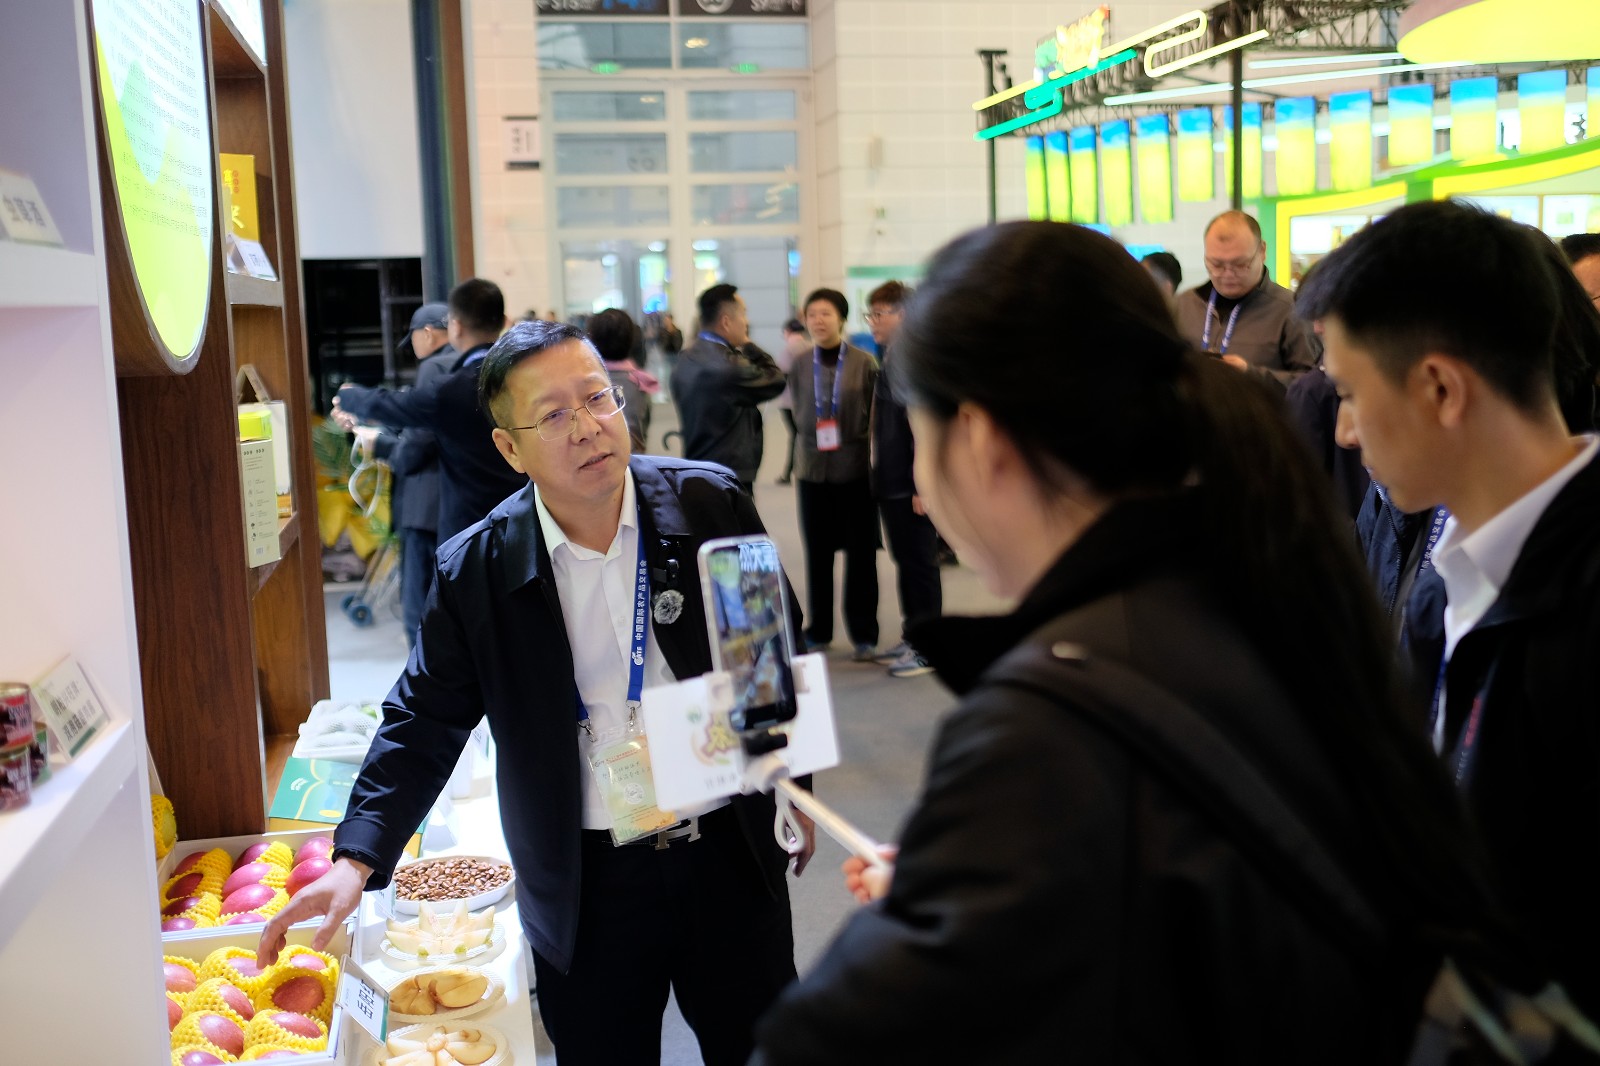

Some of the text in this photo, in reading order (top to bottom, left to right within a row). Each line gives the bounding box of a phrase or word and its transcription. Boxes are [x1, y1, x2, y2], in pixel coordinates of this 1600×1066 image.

[1420, 509, 1446, 573] 际农产品交易会
[635, 559, 647, 641] 中国国际农产品交易会
